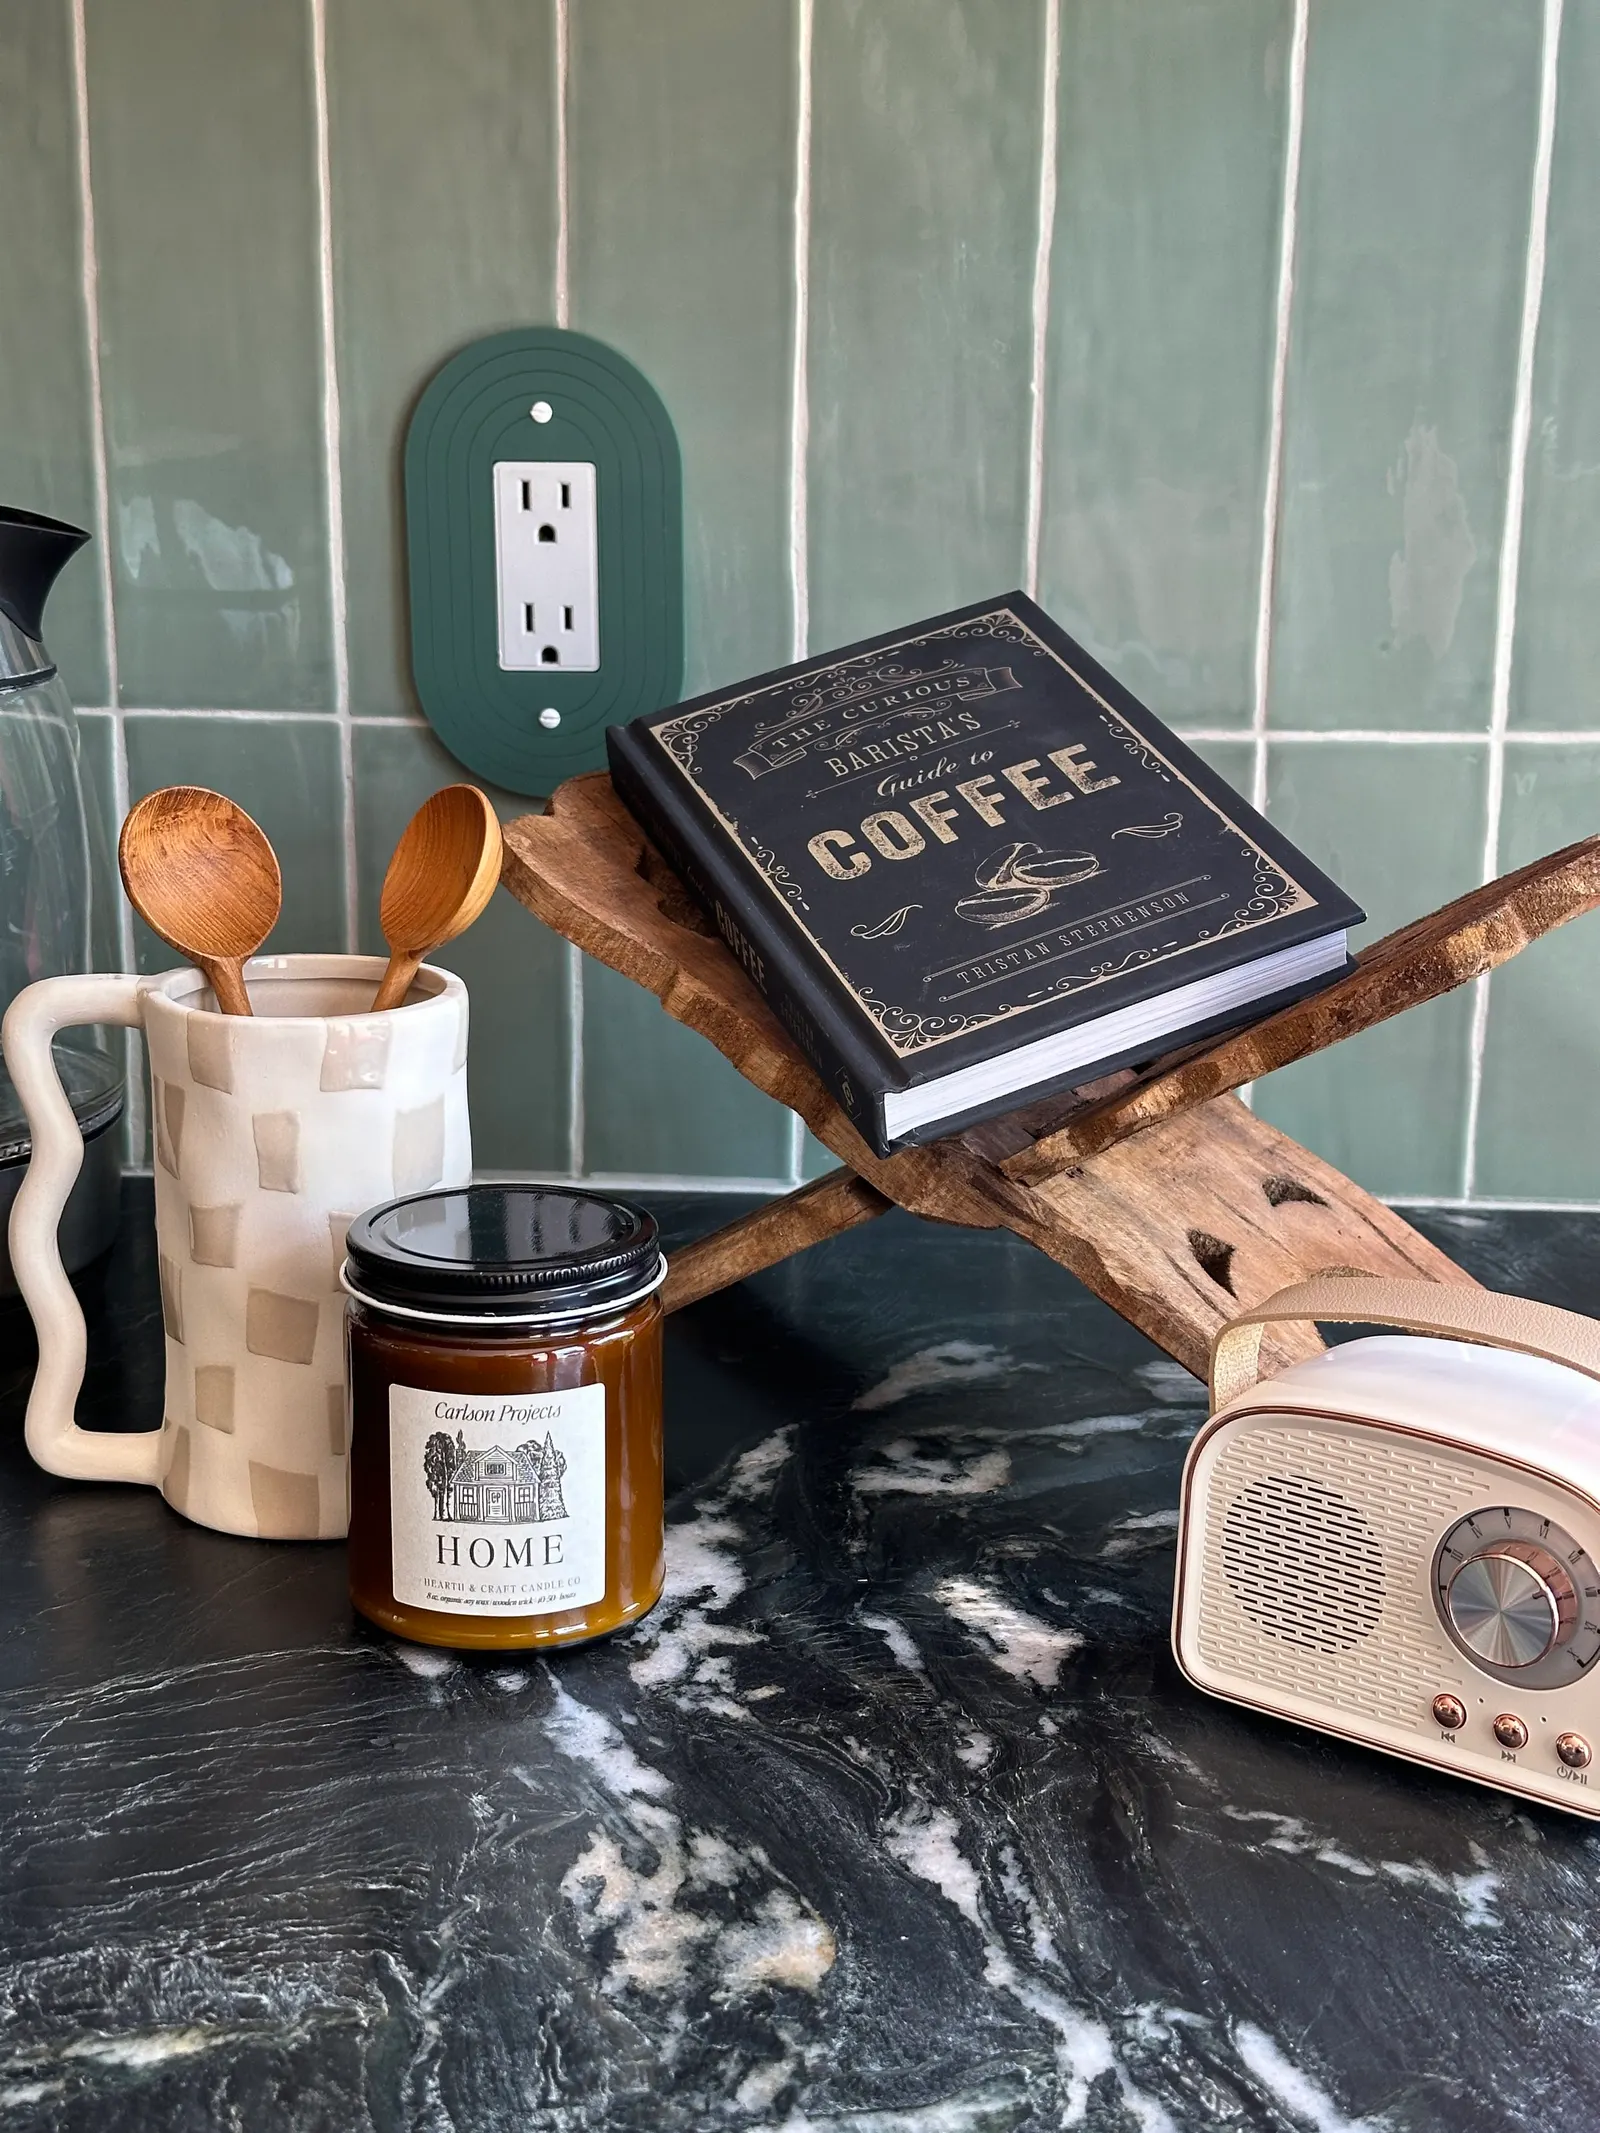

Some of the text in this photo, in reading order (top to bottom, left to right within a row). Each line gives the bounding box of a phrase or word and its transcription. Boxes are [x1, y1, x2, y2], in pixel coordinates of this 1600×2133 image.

[772, 676, 970, 749] THE CURIOUS
[823, 711, 981, 778] BARISTA'S
[877, 750, 996, 797] Guide to
[807, 743, 1122, 880] COFFEE
[715, 899, 768, 995] COFFEE
[957, 891, 1190, 984] TRISTAN STEPHENSON
[434, 1401, 562, 1425] Carlson Projects
[436, 1534, 564, 1569] HOME
[1568, 1550, 1582, 1565] VII
[424, 1577, 464, 1591] HEARTH
[469, 1584, 477, 1593] &
[481, 1584, 516, 1594] CRAFT
[521, 1579, 564, 1593] CANDLE
